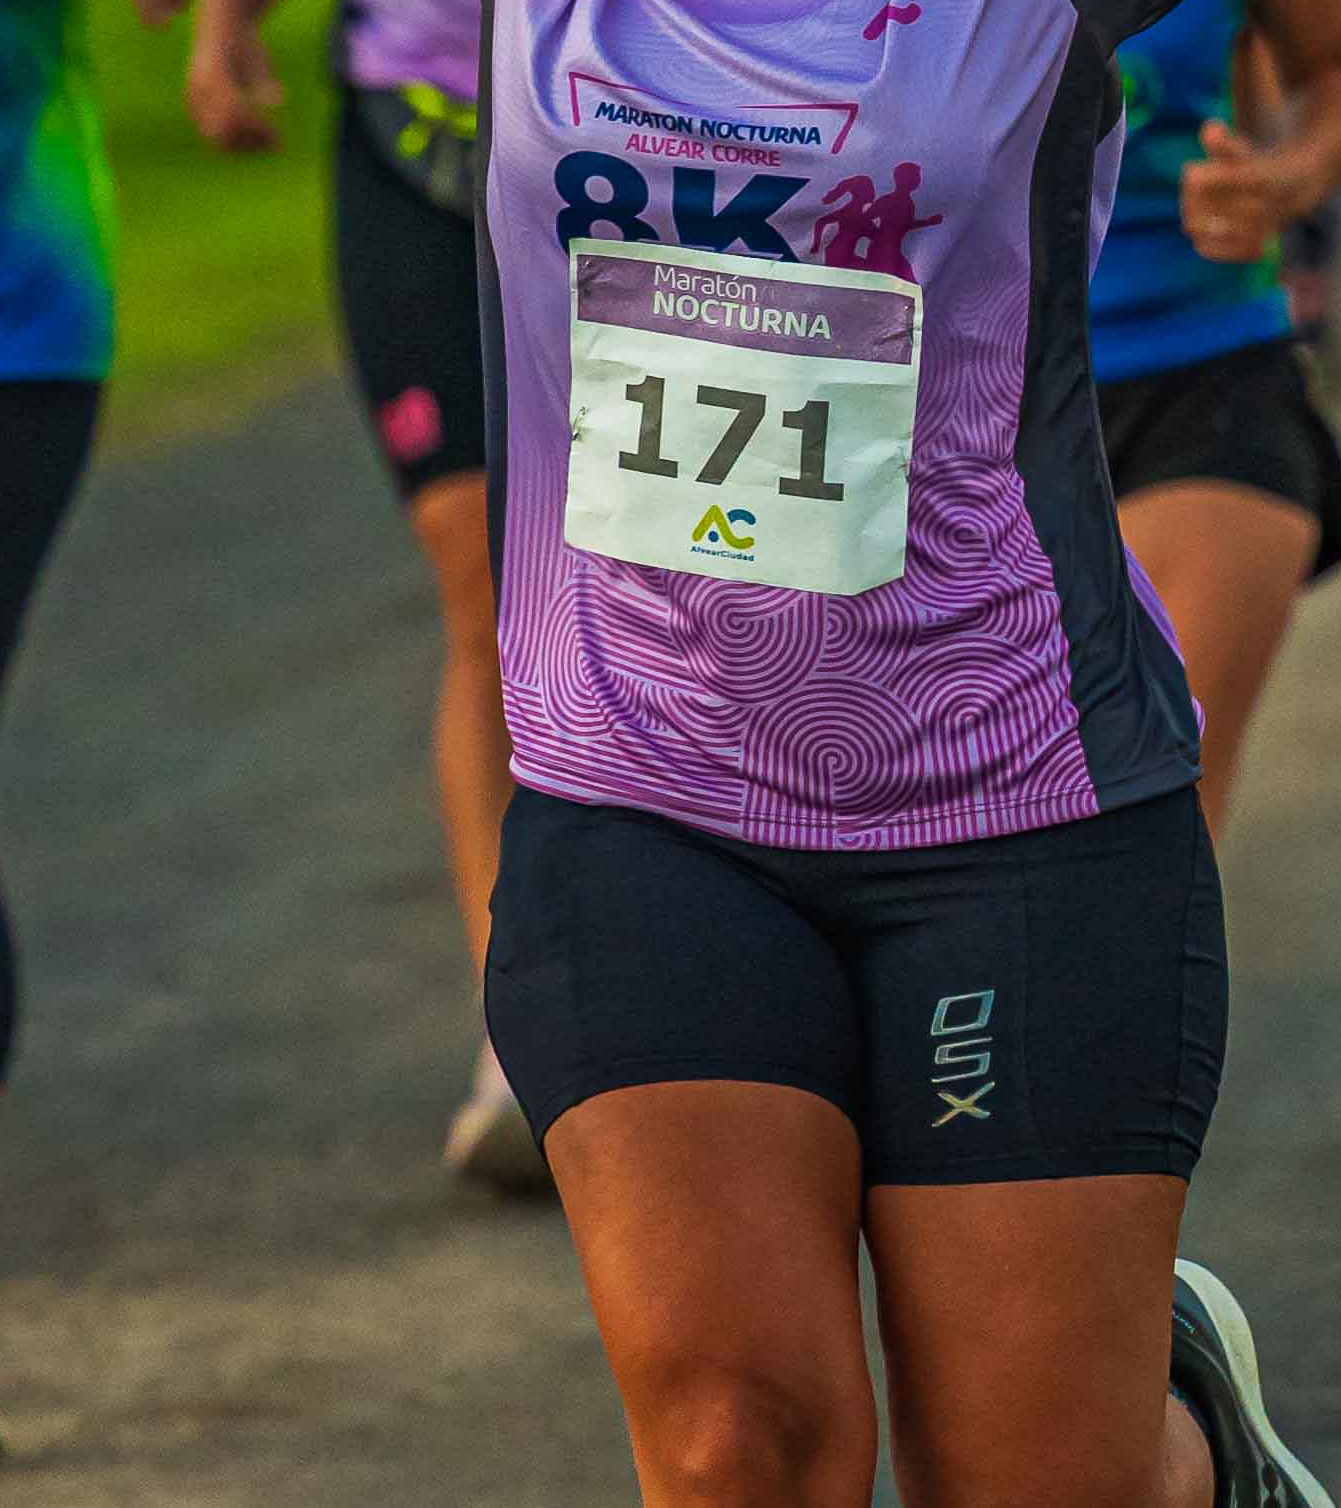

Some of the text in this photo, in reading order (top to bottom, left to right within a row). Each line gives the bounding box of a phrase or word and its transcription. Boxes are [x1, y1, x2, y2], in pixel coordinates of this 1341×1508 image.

[625, 134, 781, 167] ALVEAR CORRE
[699, 120, 821, 145] NOCTURNA
[554, 150, 811, 263] 8K
[654, 264, 757, 302] Maratón
[653, 290, 832, 340] NOCTURNA
[618, 375, 845, 502] 171
